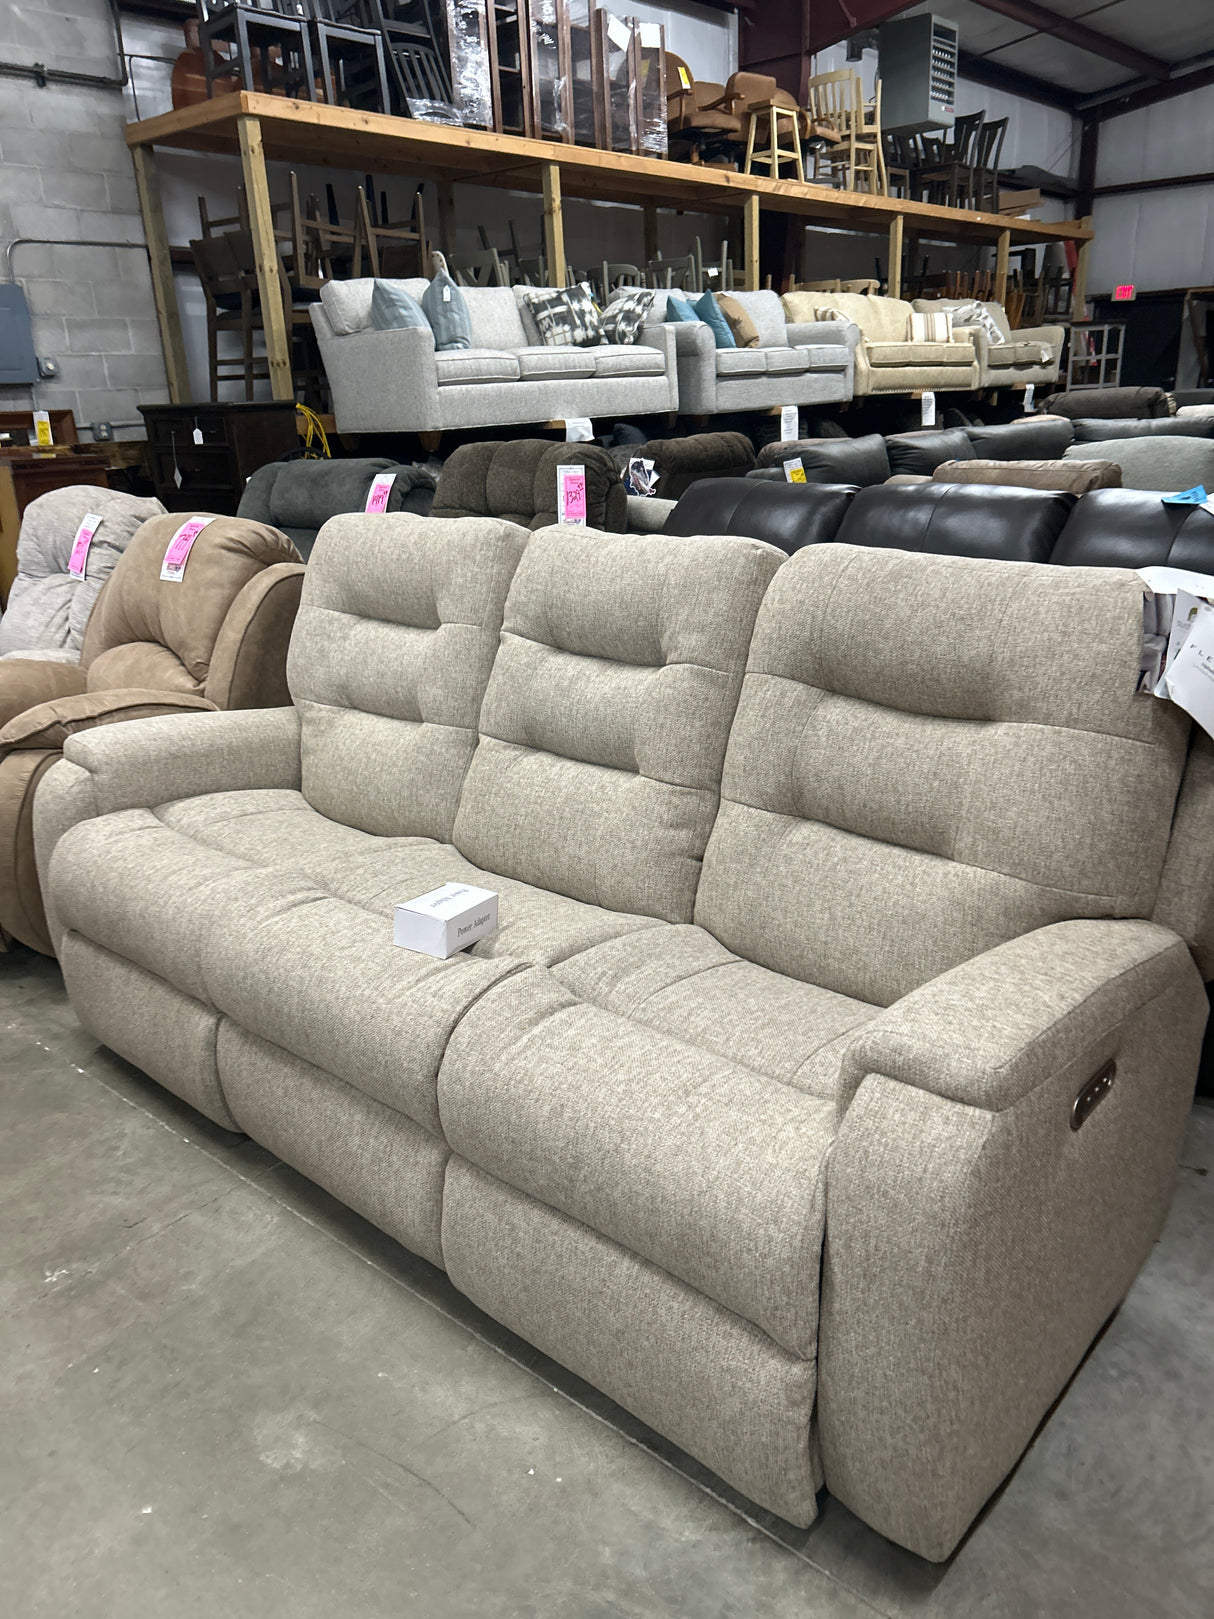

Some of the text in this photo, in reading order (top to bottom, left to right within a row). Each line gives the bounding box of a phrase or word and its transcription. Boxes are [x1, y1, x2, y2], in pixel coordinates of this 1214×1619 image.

[1115, 285, 1135, 300] EXIT
[457, 913, 491, 938] Power Adapter
